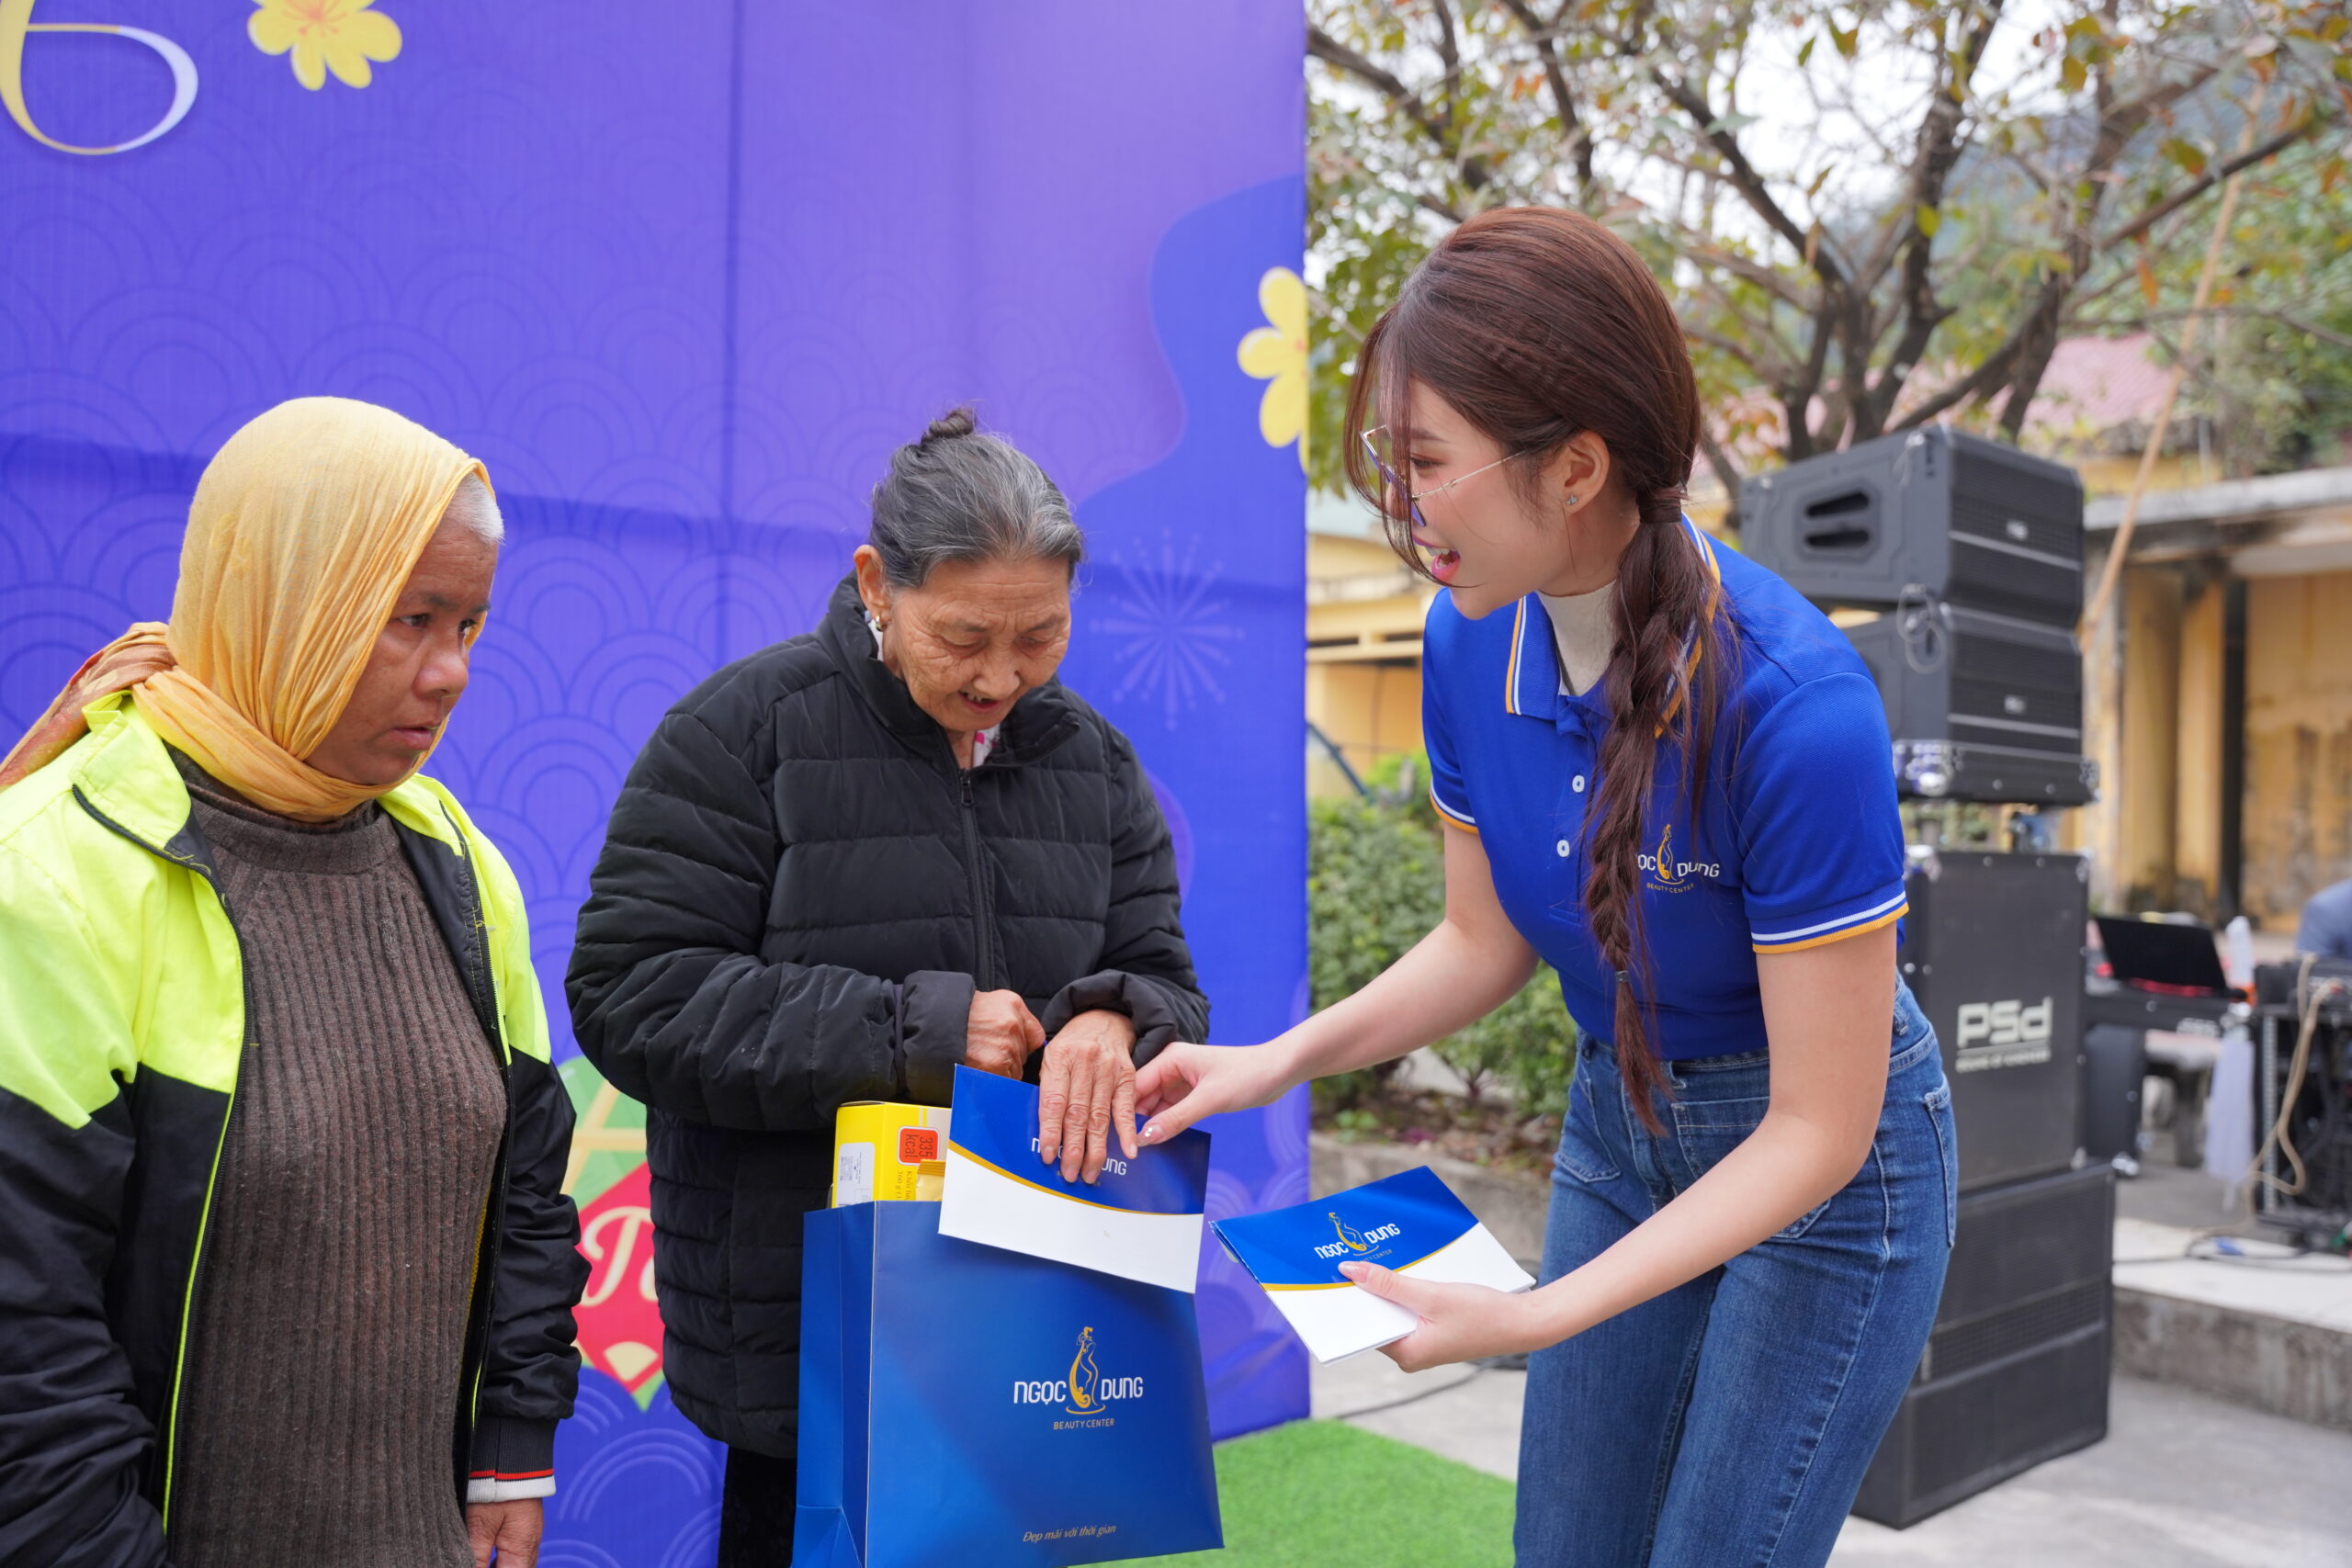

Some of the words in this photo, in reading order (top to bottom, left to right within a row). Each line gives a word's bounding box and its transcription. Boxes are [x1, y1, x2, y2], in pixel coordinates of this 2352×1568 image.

[1677, 862, 1720, 877] DUNG
[1645, 882, 1668, 892] BEAUTY
[1668, 883, 1695, 894] CENTER
[904, 1134, 920, 1158] kcal
[919, 1136, 934, 1158] 335
[1314, 1241, 1350, 1259] NGỌC
[1363, 1223, 1401, 1244] DUNG
[1013, 1381, 1067, 1405] NGỌC
[1101, 1377, 1144, 1401] DUNG
[1053, 1420, 1085, 1430] BEAUTY
[1086, 1418, 1114, 1427] CENTER
[1023, 1531, 1043, 1543] Đẹp
[1097, 1524, 1116, 1537] gian
